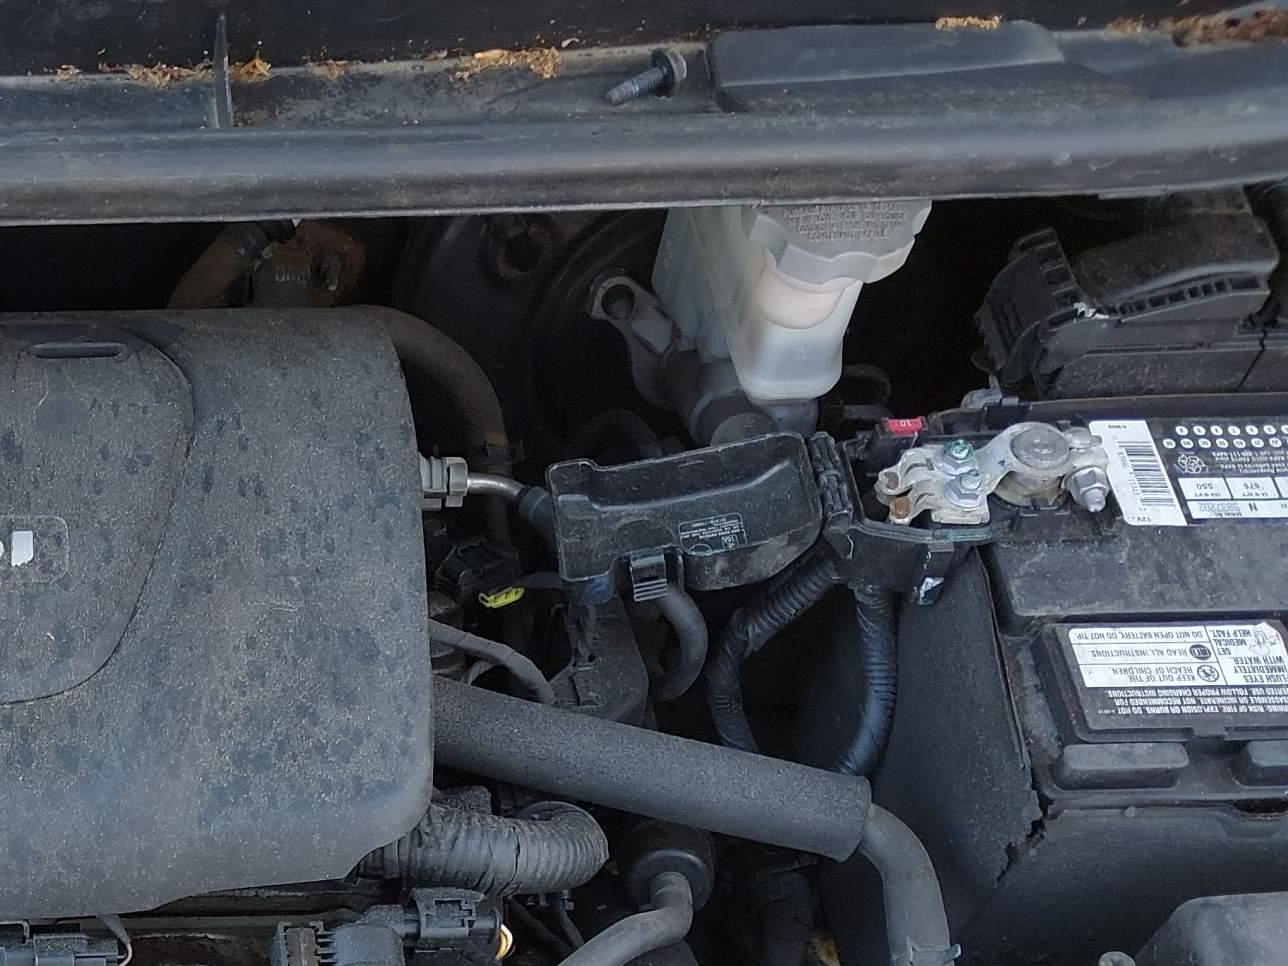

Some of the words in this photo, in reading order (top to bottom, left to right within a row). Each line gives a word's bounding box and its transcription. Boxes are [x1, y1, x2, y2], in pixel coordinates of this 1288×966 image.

[1153, 631, 1174, 639] OPEN
[1212, 638, 1248, 647] MEDICAL
[1262, 656, 1285, 665] WITH
